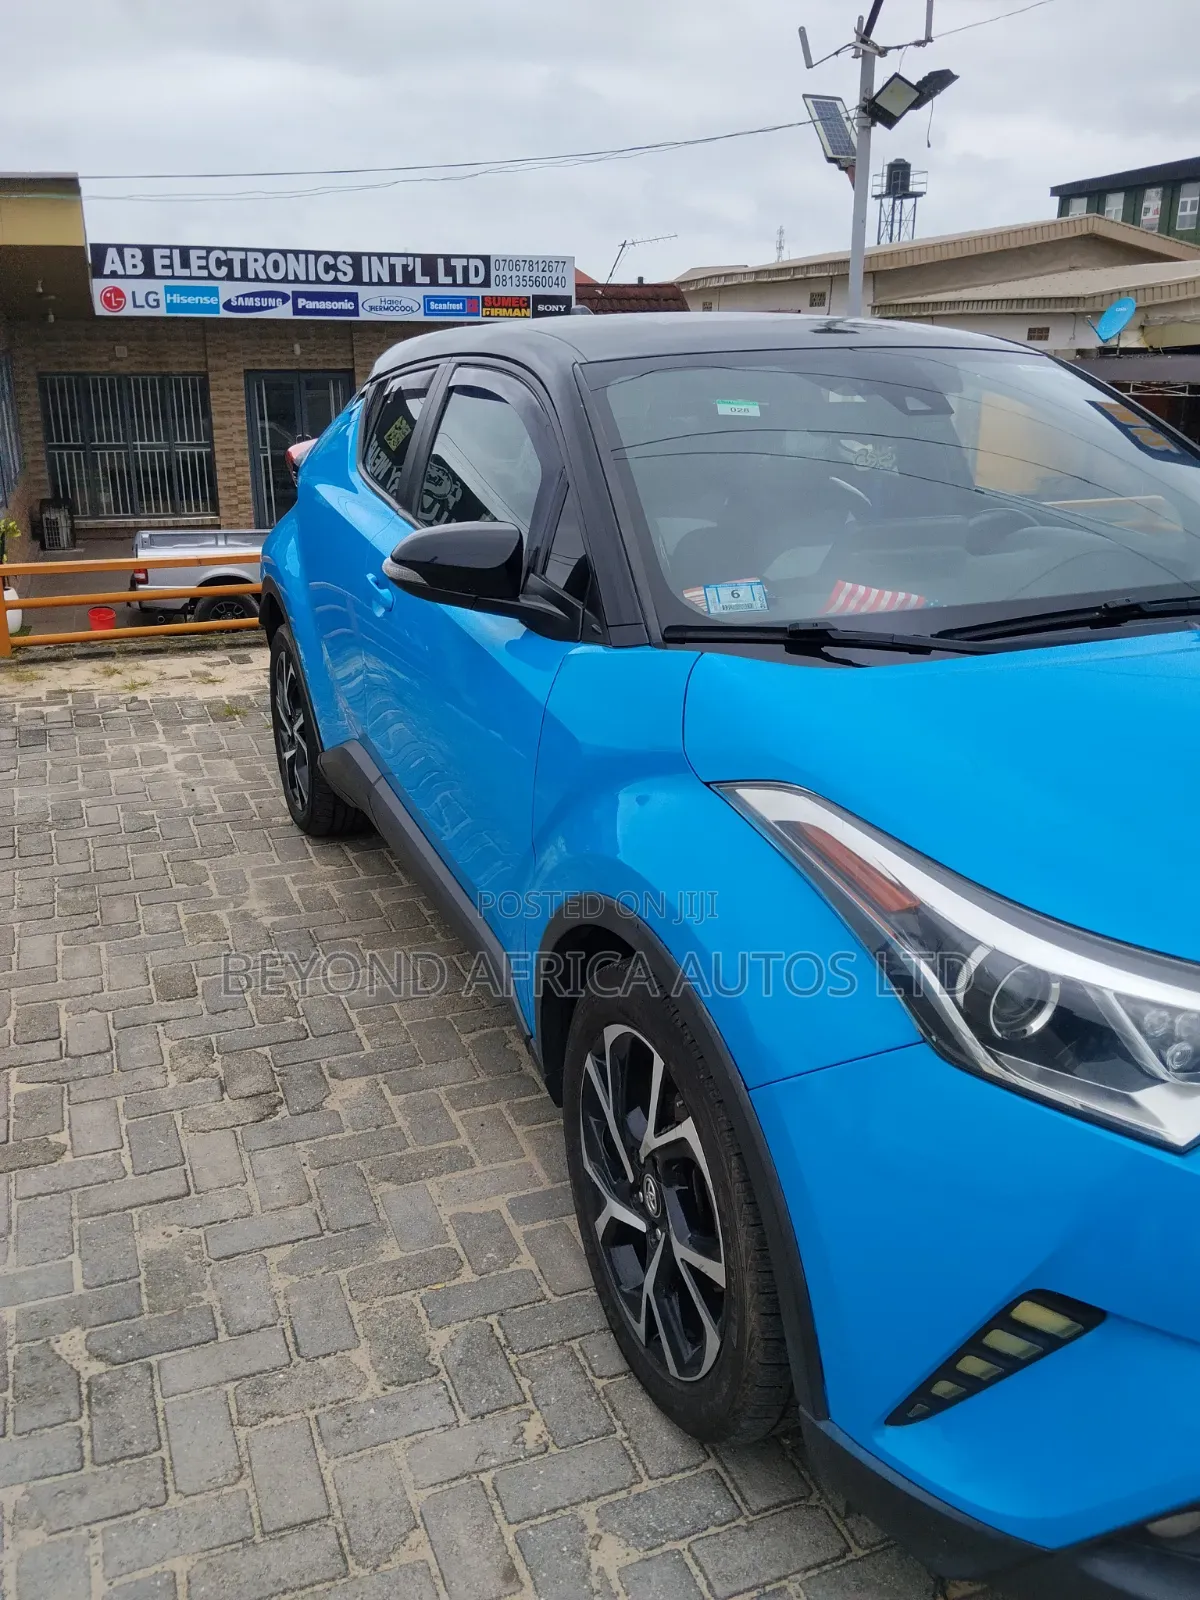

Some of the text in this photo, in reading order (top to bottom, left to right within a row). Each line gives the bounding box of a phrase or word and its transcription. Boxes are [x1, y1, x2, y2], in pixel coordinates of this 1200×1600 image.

[103, 247, 486, 285] AB ELECTRONICS INT'L LTD
[494, 259, 567, 273] 07067812677
[494, 274, 567, 288] 08135560040
[131, 290, 160, 309] LG
[166, 293, 219, 305] Hisense
[230, 295, 283, 307] SAMSUNG
[297, 298, 355, 310] Panasonic
[379, 298, 403, 306] Haier
[484, 296, 528, 307] SUMEC
[368, 305, 416, 313] THERMOCOOL
[429, 301, 463, 310] Scanfrost
[537, 304, 567, 312] SONY
[482, 308, 530, 317] FIRMAN
[730, 589, 741, 599] 6
